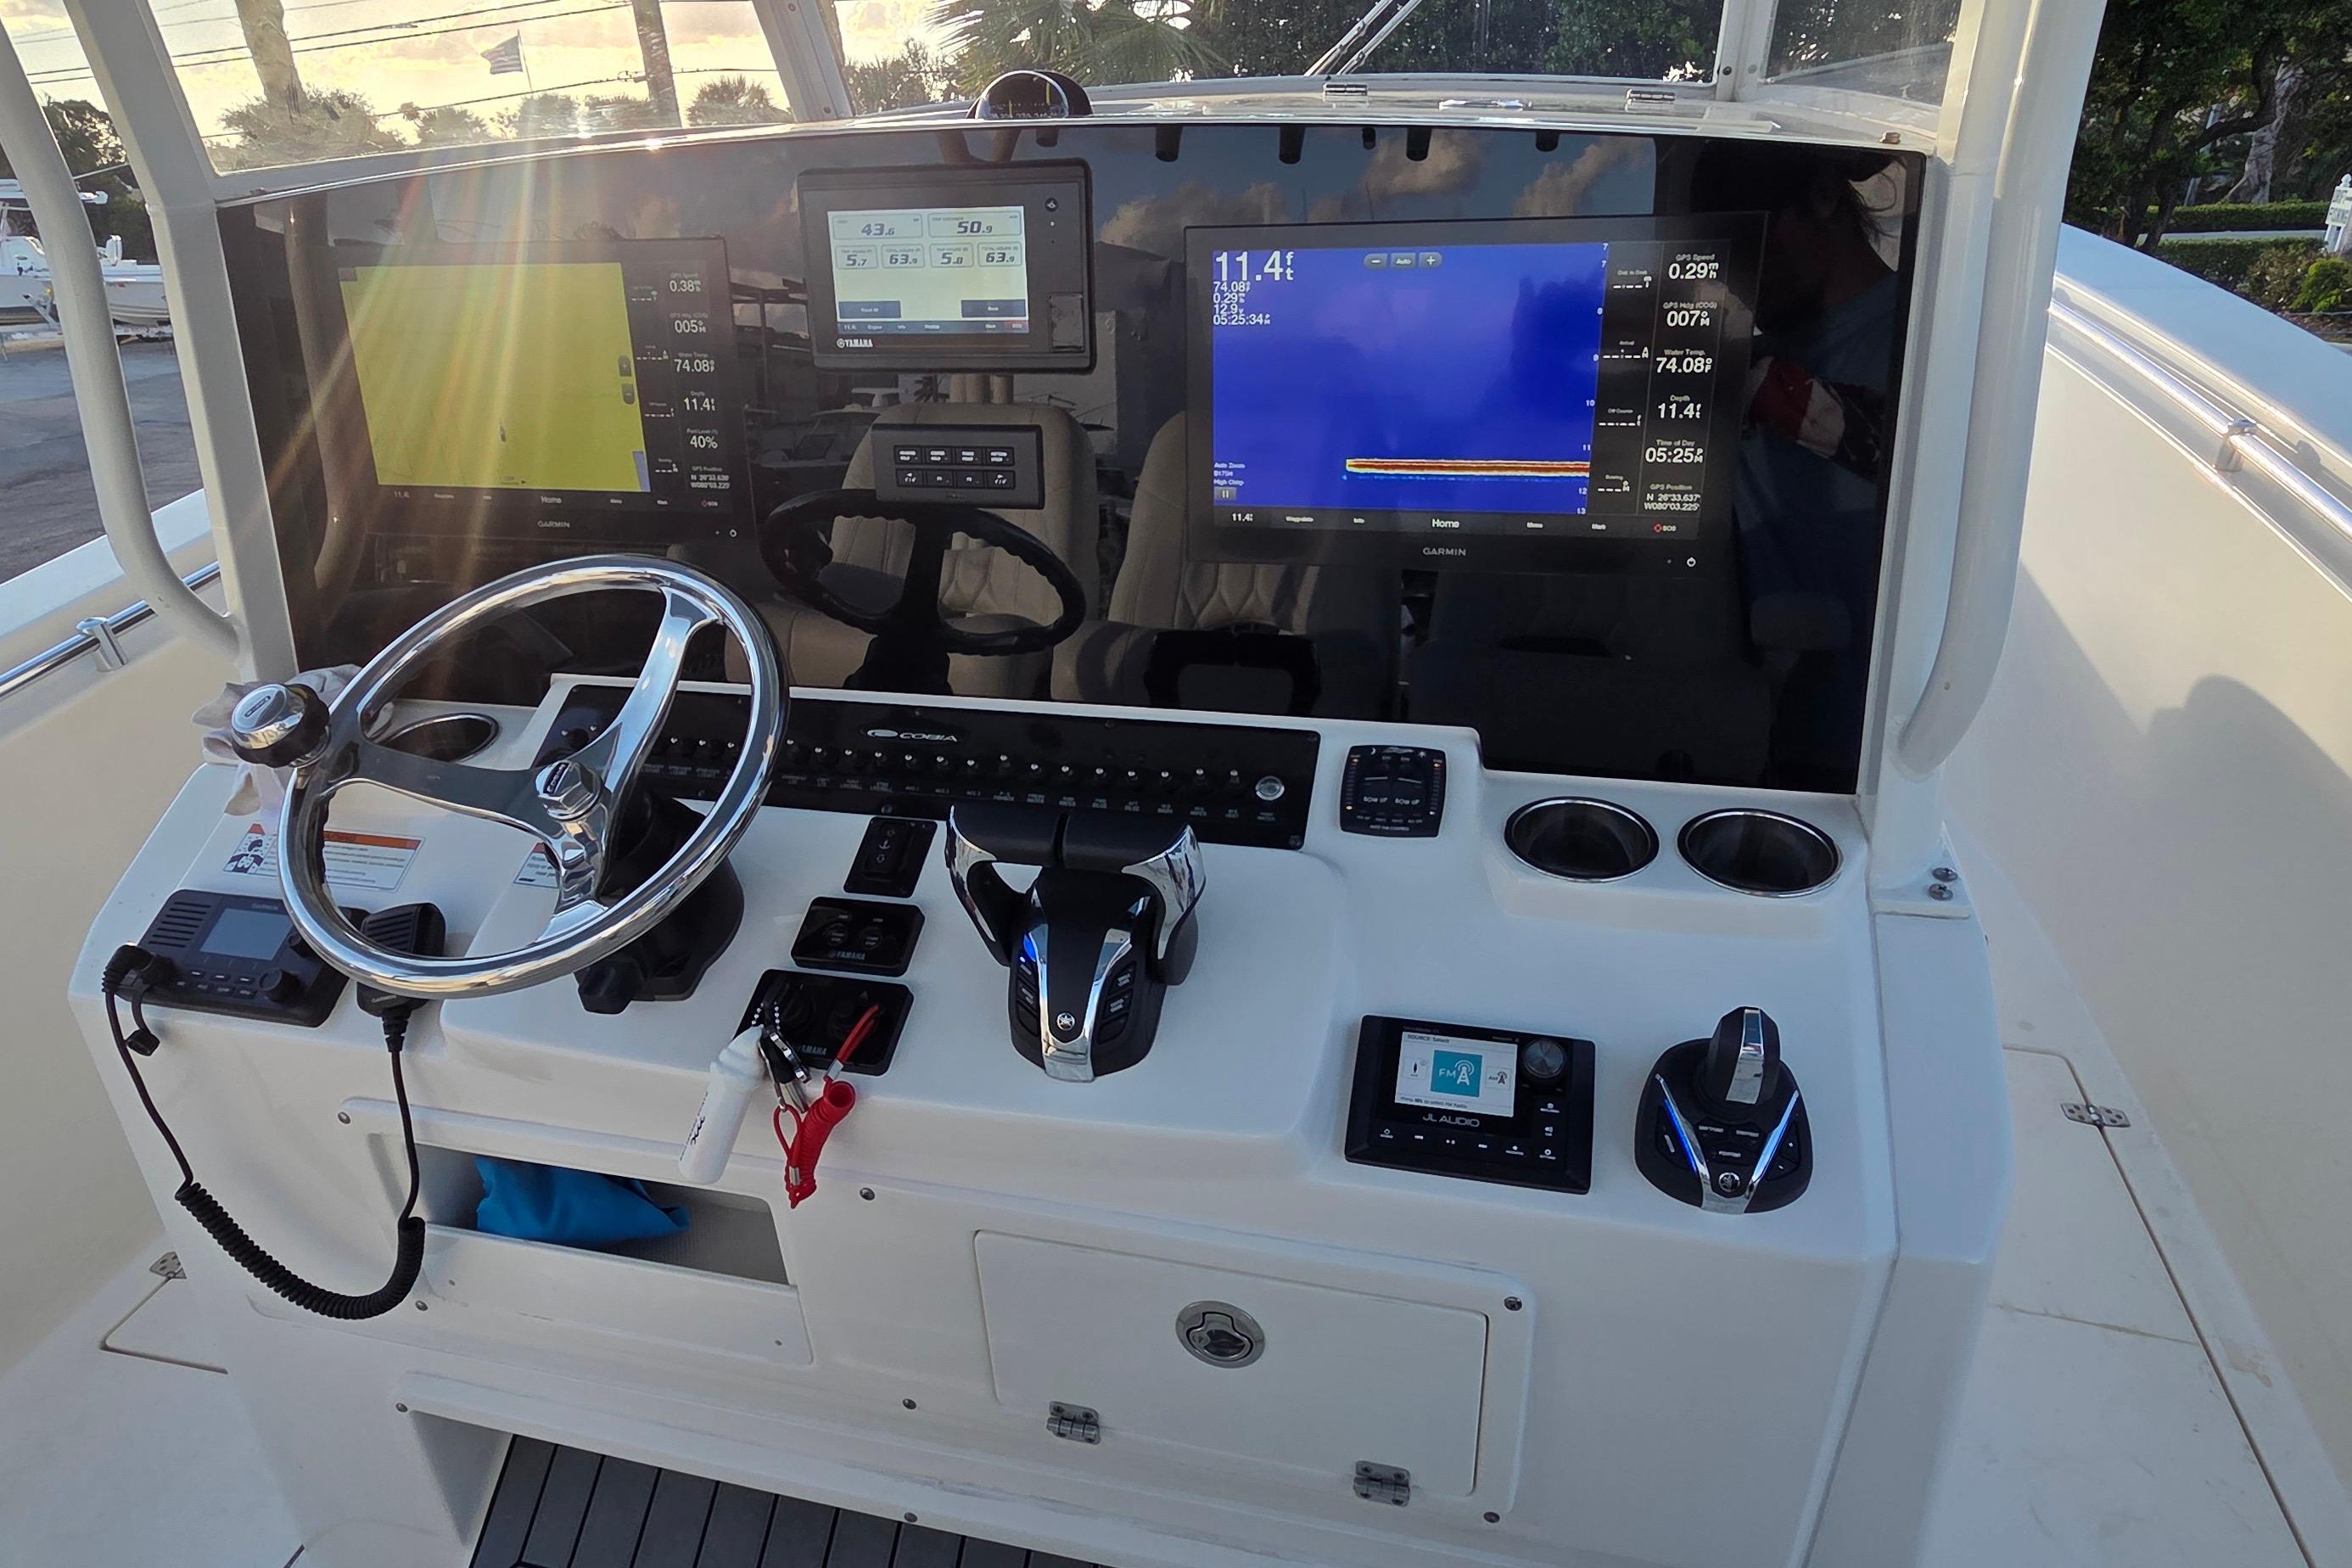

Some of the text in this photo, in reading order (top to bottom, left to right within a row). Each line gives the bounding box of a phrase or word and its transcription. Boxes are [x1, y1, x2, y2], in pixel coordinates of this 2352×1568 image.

[861, 223, 895, 236] 43.6
[957, 221, 993, 234] 50.9
[845, 255, 867, 267] 5.7
[889, 254, 918, 265] 63.9
[985, 252, 1015, 263] 63.9
[844, 339, 873, 348] YAMAHA
[690, 435, 718, 449] 40%
[1431, 518, 1460, 529] Home
[1423, 547, 1466, 557] GARMIN
[899, 732, 958, 742] COBIA
[837, 951, 865, 961] YAMAHA
[1438, 1067, 1457, 1079] FM
[1422, 1112, 1481, 1128] JL AUDIO
